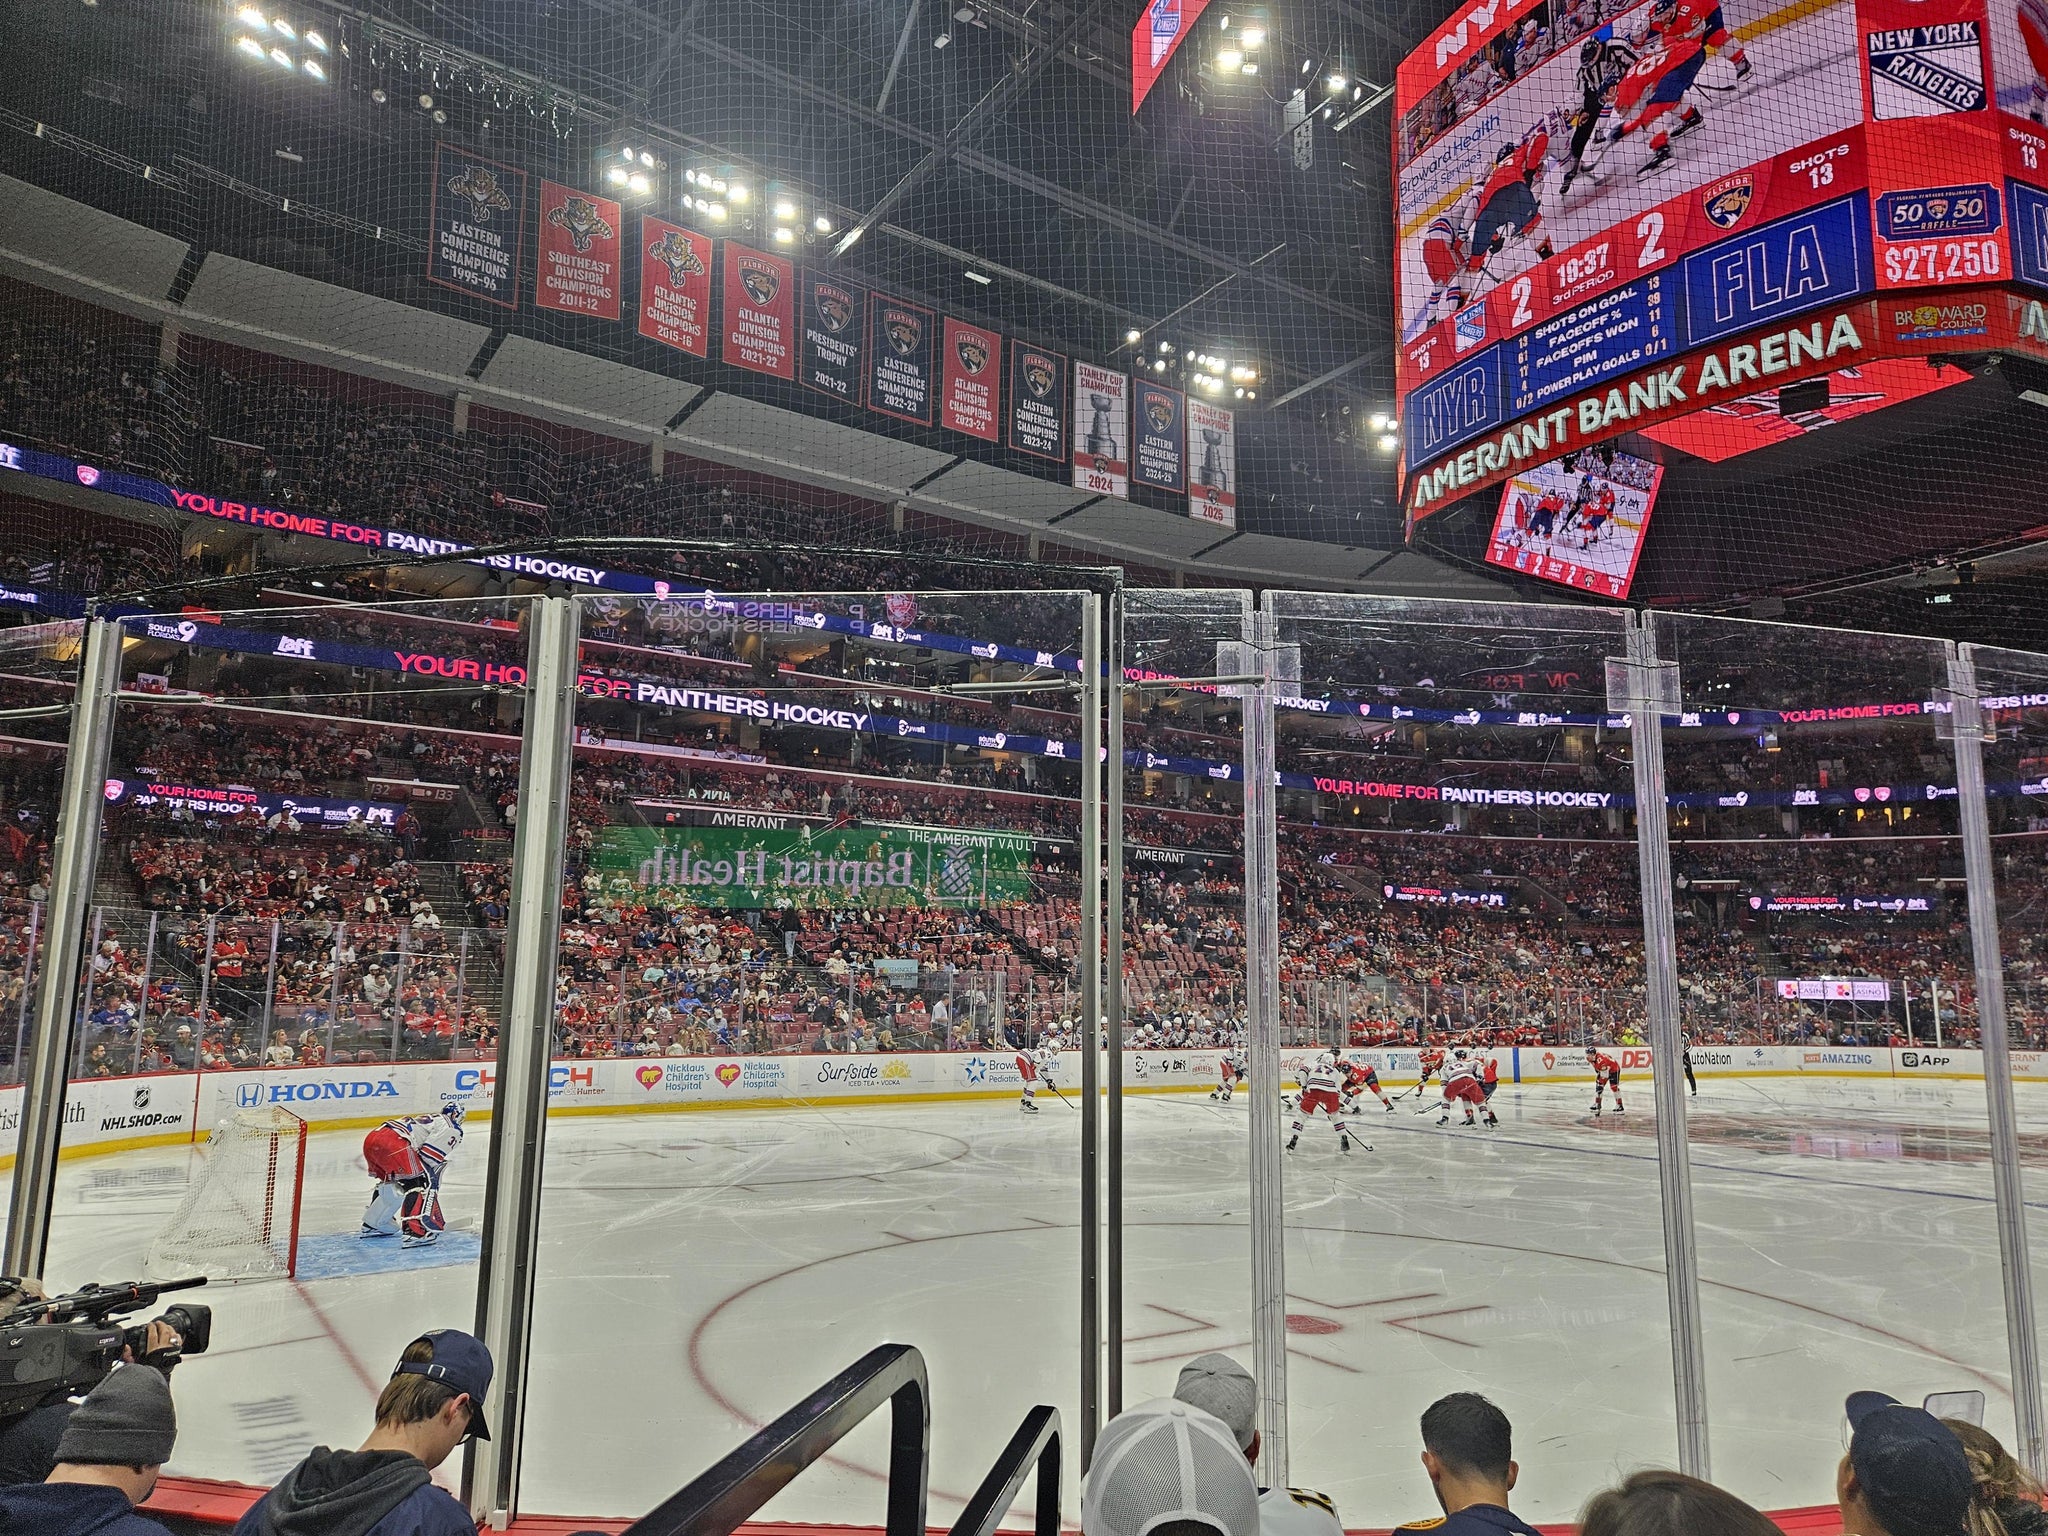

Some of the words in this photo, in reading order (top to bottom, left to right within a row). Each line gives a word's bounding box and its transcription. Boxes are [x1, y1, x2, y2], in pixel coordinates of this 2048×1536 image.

[1870, 29, 1915, 51] NEW
[1921, 21, 1977, 45] YORK
[1886, 55, 1979, 108] RANGERS
[2009, 128, 2046, 149] SHOTS
[1400, 148, 1451, 197] Broward
[1452, 114, 1502, 156] Health
[1789, 144, 1849, 173] SHOTS
[2021, 145, 2037, 169] 13
[1400, 180, 1439, 214] Pediatric
[1441, 150, 1483, 183] Services
[1809, 163, 1833, 188] 13
[1705, 176, 1749, 199] FLORIDA
[1893, 204, 1923, 224] 50
[1953, 199, 1983, 218] 50
[452, 221, 500, 248] EASTERN
[1921, 220, 1957, 229] RAFFLE
[441, 231, 510, 266] CONFERENCE
[1637, 212, 1665, 268] 2
[441, 247, 506, 279] CHAMPIONS
[548, 251, 611, 273] SOUTHEAST
[1885, 240, 1999, 283] $27,250
[451, 266, 496, 291] 1995-96
[555, 265, 603, 285] DIVISION
[1713, 224, 1829, 323] FLA
[546, 277, 611, 298] CHAMPIONS
[655, 285, 696, 310] ATLANTIC
[1552, 289, 1570, 305] 3rd
[1571, 270, 1614, 295] PERIOD
[559, 293, 598, 310] 2011-12
[655, 297, 694, 322] DIVISION
[1511, 276, 1533, 329] 2
[1535, 313, 1575, 340] SHOTS
[1578, 303, 1597, 319] ON
[1599, 287, 1637, 310] GOAL
[1647, 276, 1660, 290] 13
[647, 307, 701, 336] CHAMPIONS
[739, 307, 780, 329] ATLANTIC
[1548, 316, 1608, 349] FACEOFF
[1611, 308, 1621, 320] %
[1941, 317, 1985, 329] COUNTY
[658, 326, 692, 347] 2015-16
[739, 321, 779, 341] DIVISION
[1536, 332, 1603, 369] FACEOFFS
[1605, 317, 1639, 338] WON
[1648, 308, 1661, 322] 11
[732, 332, 785, 356] CHAMPIONS
[807, 329, 857, 357] PRESIDENTS'
[1409, 337, 1437, 360] SHOTS
[741, 349, 777, 368] 2021-22
[816, 346, 847, 367] TROPHY
[884, 357, 918, 376] EASTERN
[1418, 352, 1430, 372] 13
[1573, 350, 1597, 368] PIM
[815, 371, 847, 393] 2021-22
[877, 367, 925, 390] CONFERENCE
[1079, 366, 1107, 382] STANLEY
[1110, 374, 1123, 386] CUP
[1516, 392, 1534, 410] 0/2
[1537, 374, 1572, 399] POWER
[1572, 364, 1601, 386] PLAY
[1601, 348, 1640, 372] GOALS
[1644, 338, 1667, 356] 0/1
[878, 379, 924, 402] CHAMPIONS
[955, 378, 988, 396] ATLANTIC
[1081, 378, 1122, 397] CHAMPIONS
[884, 394, 917, 412] 2022-23
[955, 391, 987, 407] DIVISION
[1023, 400, 1053, 416] EASTERN
[1423, 364, 1486, 449] NYR
[950, 400, 992, 421] CHAMPIONS
[1016, 408, 1059, 430] CONFERENCE
[1414, 405, 1574, 509] AMERANT
[1578, 364, 1688, 434] BANK
[1696, 313, 1864, 396] ARENA
[955, 414, 986, 431] 2023-24
[1018, 421, 1058, 441] CHAMPIONS
[1194, 414, 1230, 432] CHAMPIONS
[1023, 434, 1052, 451] 2023-24
[1140, 444, 1179, 462] CONFERENCE
[1145, 435, 1173, 451] EASTERN
[1140, 455, 1177, 473] CHAMPIONS
[1089, 474, 1113, 492] 2024
[1146, 468, 1172, 483] 2024-25
[1203, 505, 1223, 520] 2025
[171, 489, 247, 521] YOUR
[251, 508, 327, 536] HOME
[332, 523, 382, 546] FOR
[515, 555, 606, 585] HOCKEY
[1533, 556, 1544, 576] 2
[1566, 566, 1576, 584] 2
[148, 623, 178, 634] SOUTH
[394, 651, 479, 681] YOUR
[578, 675, 631, 700] FOR
[637, 683, 768, 718] PANTHERS
[773, 701, 868, 731] HOCKEY
[1193, 682, 1217, 694] FOR
[1280, 697, 1330, 712] HOCKEY
[1780, 709, 1826, 724] YOUR
[1830, 705, 1880, 720] HOME
[1883, 702, 1919, 716] FOR
[148, 784, 185, 796] YOUR
[186, 788, 227, 802] HOME
[230, 792, 257, 803] FOR
[371, 783, 390, 795] 132
[435, 789, 453, 800] 133
[1313, 777, 1353, 794] YOUR
[1356, 781, 1401, 798] HOME
[1406, 785, 1438, 800] FOR
[1442, 787, 1534, 805] PANTHERS
[1537, 791, 1610, 807] HOCKEY
[711, 812, 787, 831] AMERANT
[908, 829, 931, 843] THE
[934, 833, 995, 849] AMERANT
[998, 838, 1038, 852] VAULT
[1135, 849, 1185, 863] AMERANT
[667, 1063, 705, 1072] Nicklaus
[744, 1062, 780, 1071] Nicklaus
[1399, 1054, 1419, 1062] TROPICAL
[1692, 1052, 1731, 1065] utoNation
[1822, 1053, 1872, 1064] AMAZING
[2009, 1053, 2041, 1062] ERANT
[666, 1072, 710, 1082] Children's
[744, 1070, 784, 1080] Children's
[818, 1061, 878, 1082] Surfside
[989, 1075, 1020, 1084] Pediatric
[268, 1080, 399, 1102] HONDA
[577, 1088, 605, 1096] Hunter
[665, 1081, 702, 1092] Hospital
[743, 1079, 778, 1089] Hospital
[440, 1091, 472, 1101] Cooper
